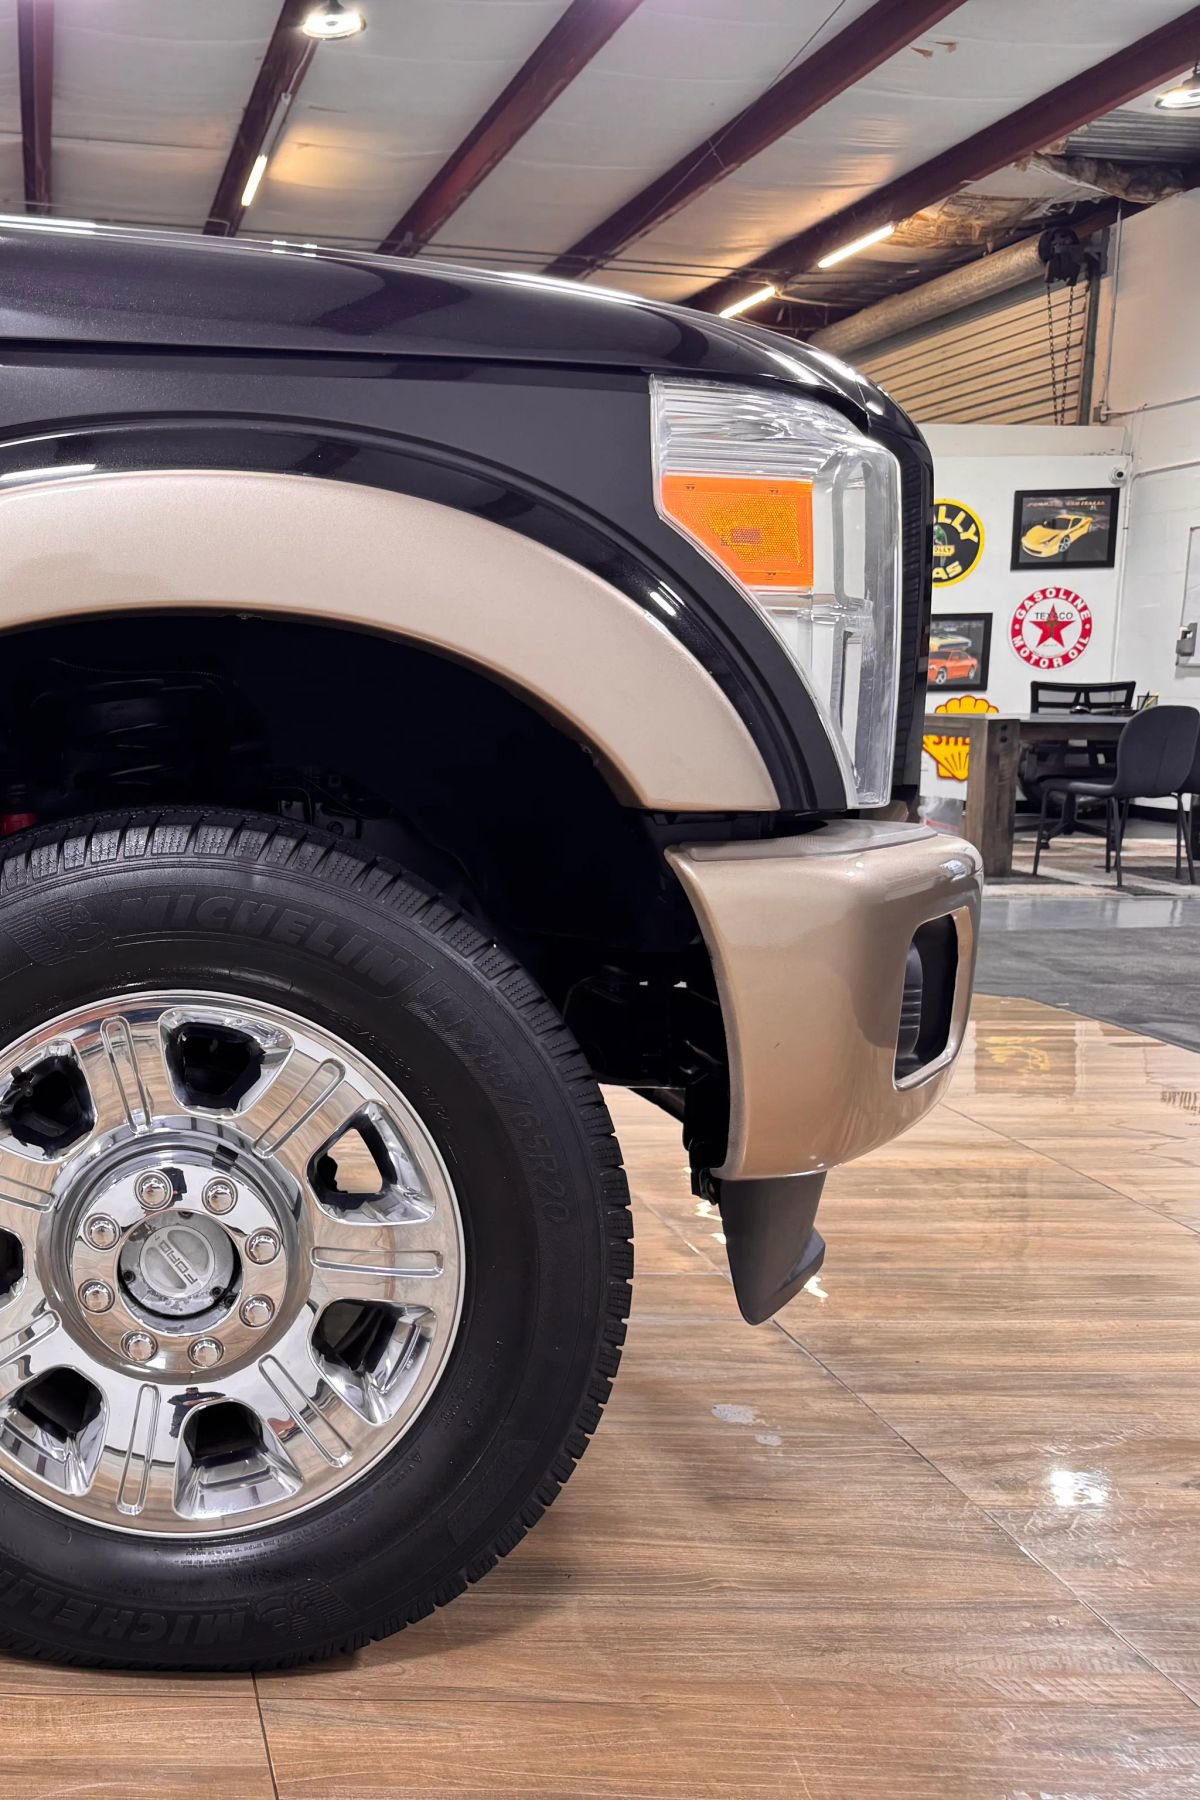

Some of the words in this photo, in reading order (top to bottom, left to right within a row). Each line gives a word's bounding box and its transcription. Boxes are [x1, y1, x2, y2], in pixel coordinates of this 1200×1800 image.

[933, 505, 979, 543] LLY
[932, 561, 962, 580] AS
[1015, 587, 1091, 620] GASOLINE
[1012, 635, 1064, 668] MOTOR
[1068, 637, 1090, 660] OIL
[111, 893, 411, 995] MICHELIN
[159, 1240, 199, 1286] FORD
